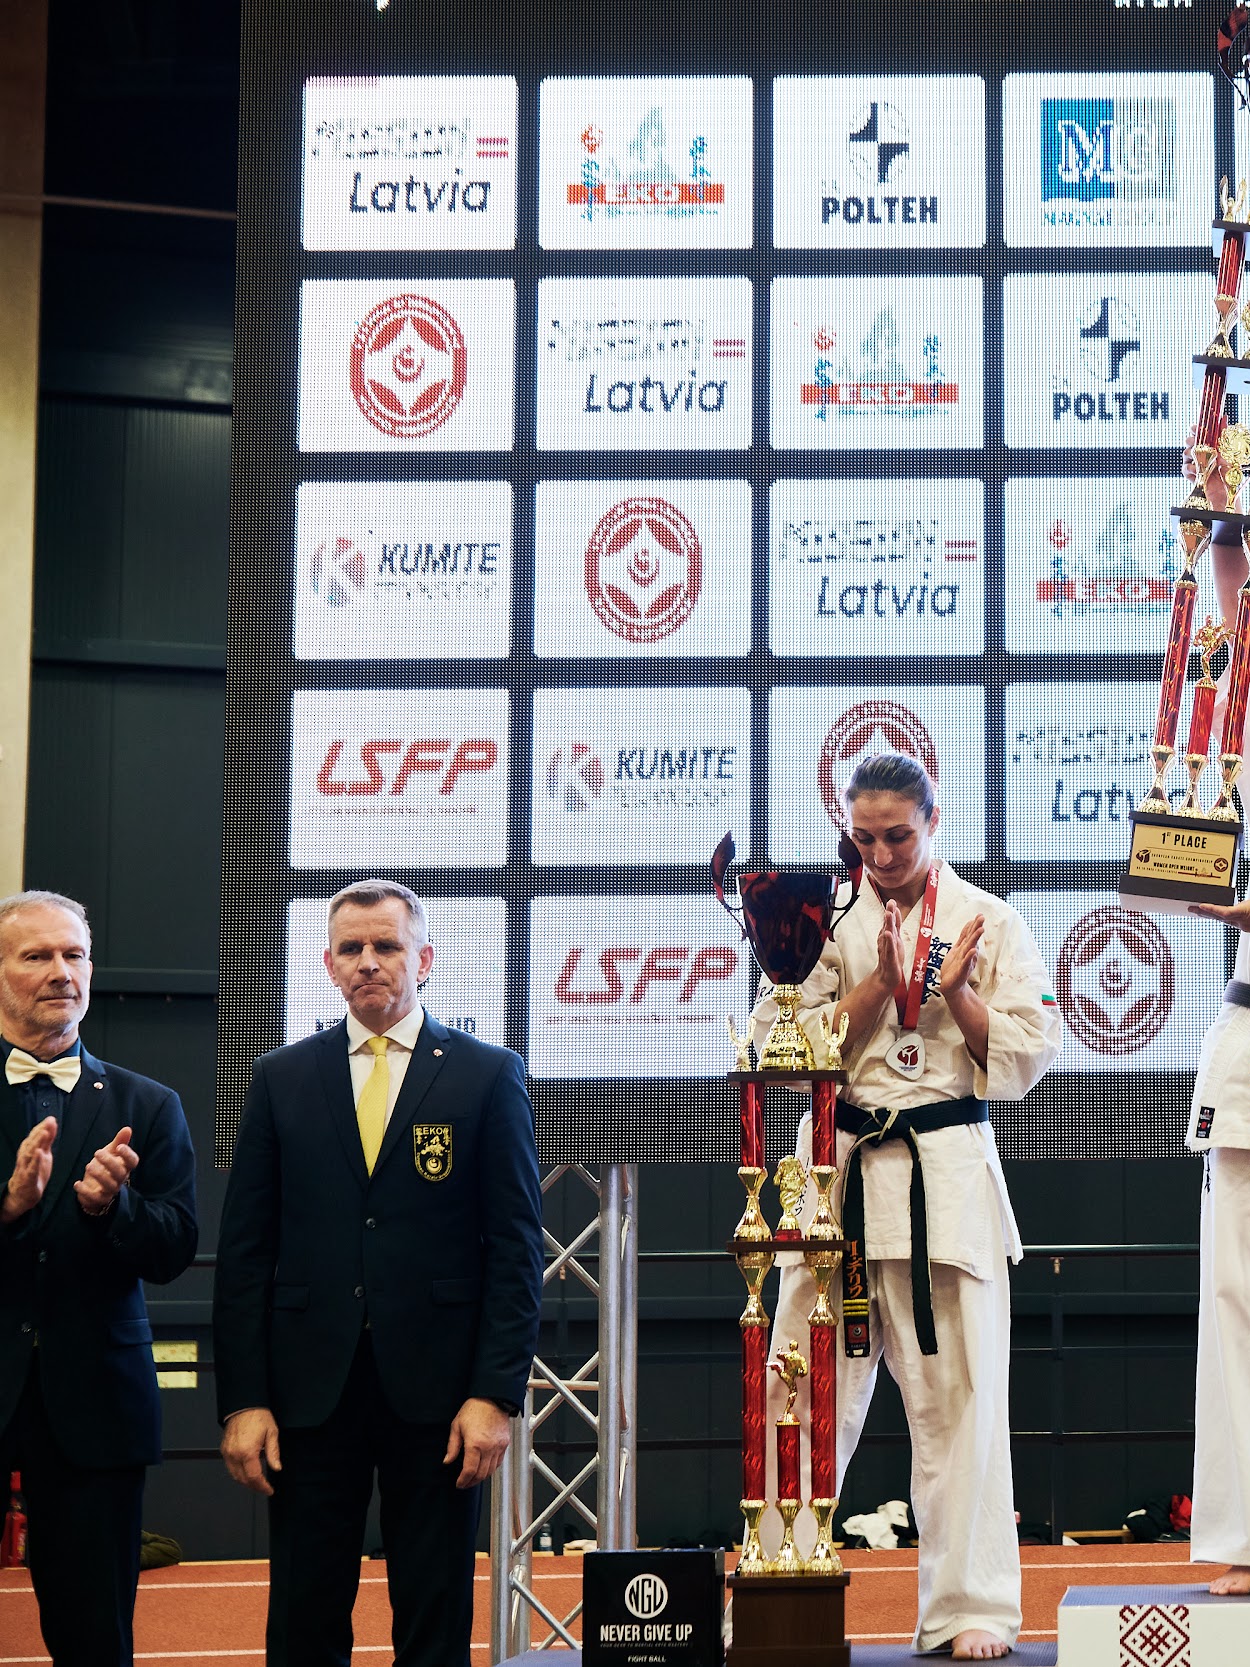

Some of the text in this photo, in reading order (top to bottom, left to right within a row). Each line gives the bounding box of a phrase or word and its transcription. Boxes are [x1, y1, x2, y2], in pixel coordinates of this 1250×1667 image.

[350, 169, 492, 213] Latvia
[822, 196, 938, 224] POLTEH
[584, 371, 728, 414] Latvia
[839, 384, 915, 404] EKO
[1052, 392, 1169, 421] POLTEH
[377, 542, 502, 575] KUMITE
[816, 572, 960, 618] Latvia
[1074, 579, 1151, 601] EKO
[316, 739, 498, 796] LSFP
[614, 746, 738, 780] KUMITE
[1174, 833, 1208, 849] PLACE
[555, 948, 740, 1004] LSFP
[422, 1126, 443, 1136] EKO
[625, 1575, 668, 1619] NGU
[600, 1624, 693, 1642] NEVER GIVE UP
[627, 1654, 667, 1663] FIGHT BALL
